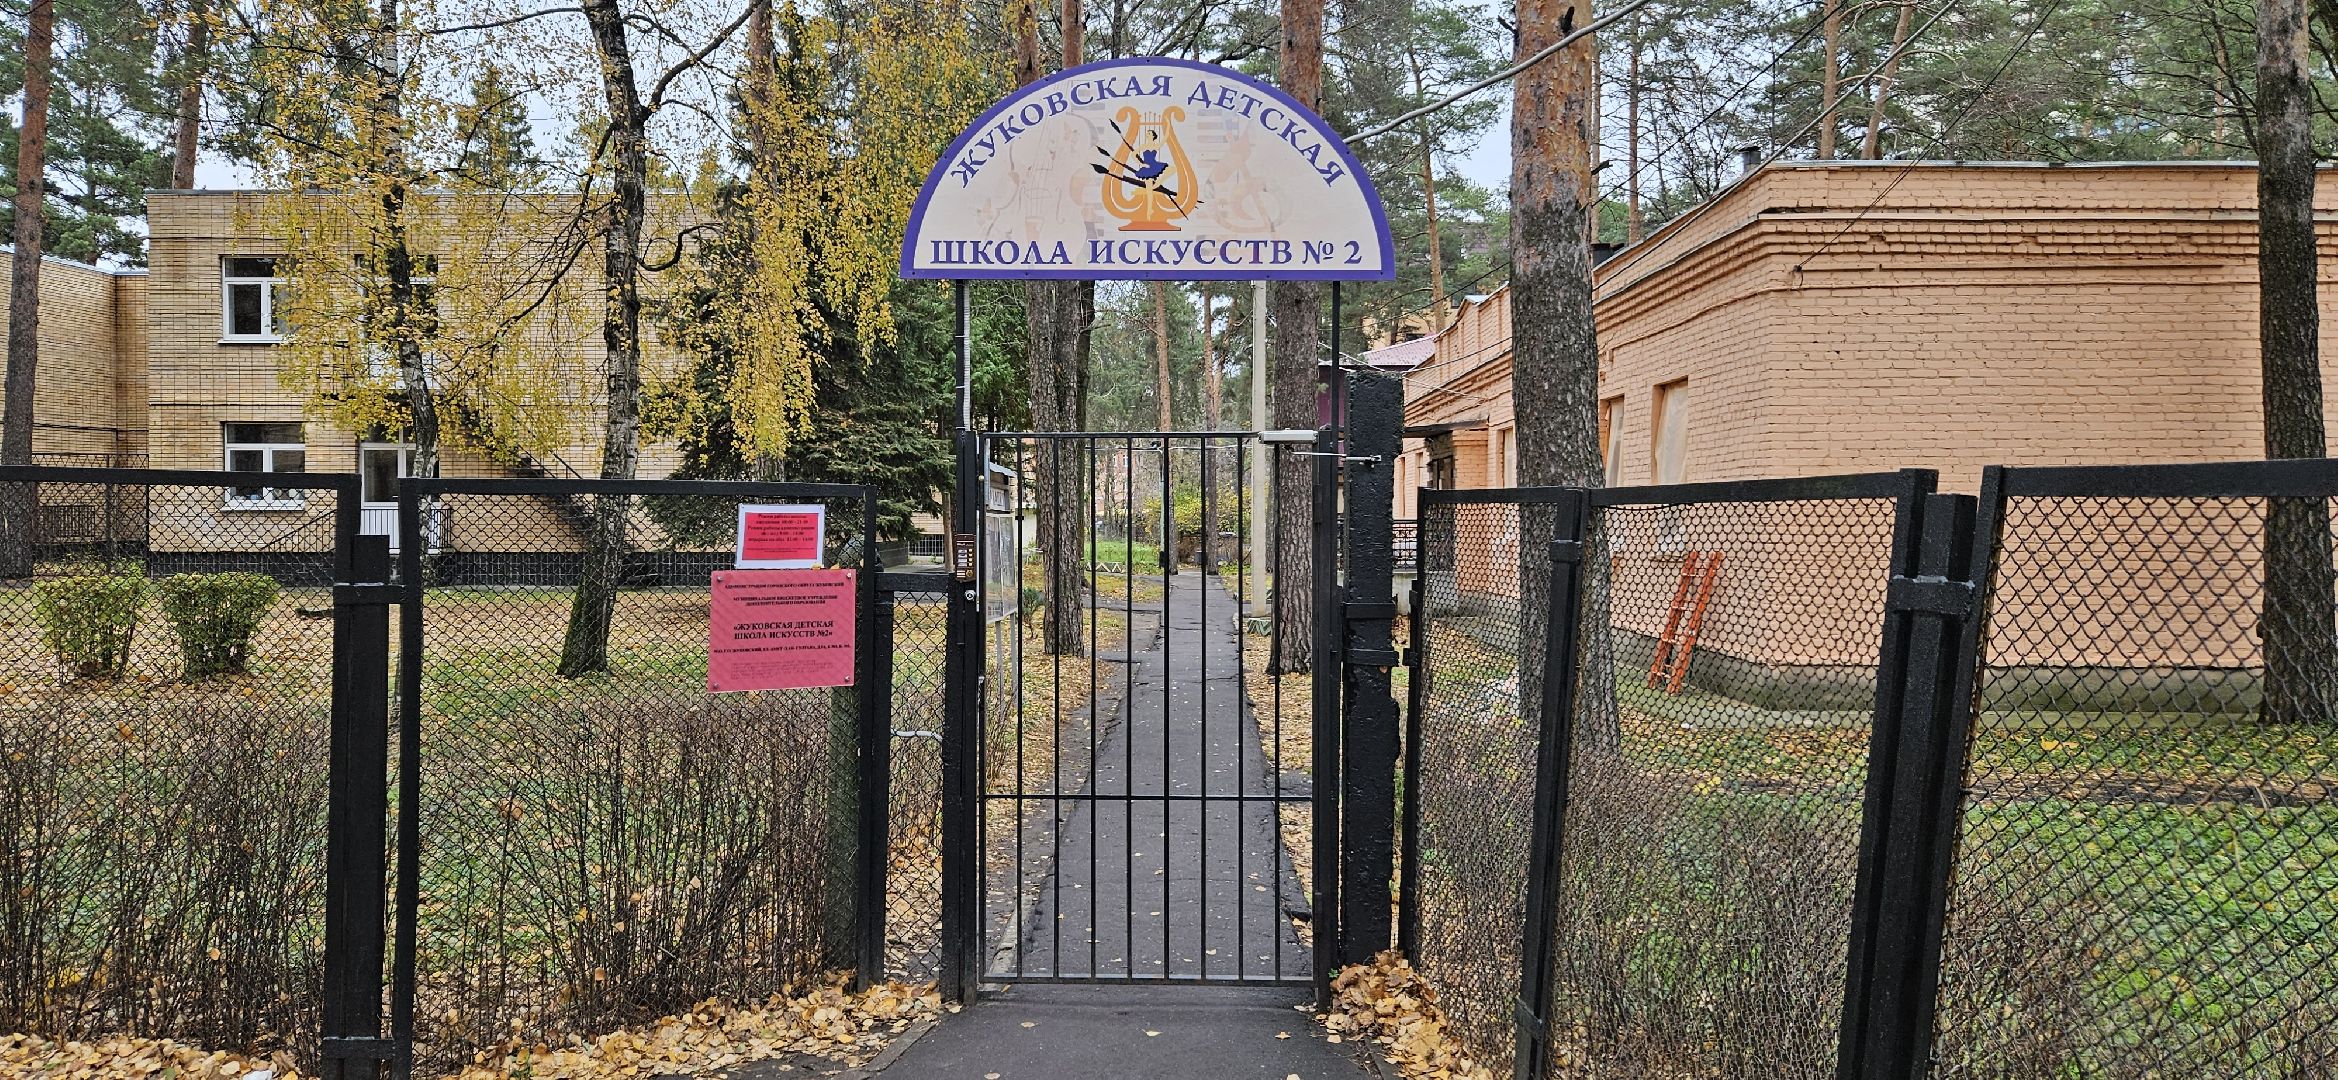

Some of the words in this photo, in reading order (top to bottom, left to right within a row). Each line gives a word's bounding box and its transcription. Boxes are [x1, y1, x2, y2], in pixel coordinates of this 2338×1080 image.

[950, 75, 1173, 188] ЖУКОВСКАЯ
[1187, 80, 1346, 187] ДЕТСКАЯ
[930, 239, 1072, 265] ШКОЛА
[1087, 239, 1293, 265] ИСКУССТВ
[1301, 239, 1334, 265] №
[1343, 239, 1363, 265] 2
[794, 620, 834, 630] ДЕТСКАЯ
[734, 630, 767, 640] ШКОЛА
[769, 630, 815, 640] ИСКУССТВ
